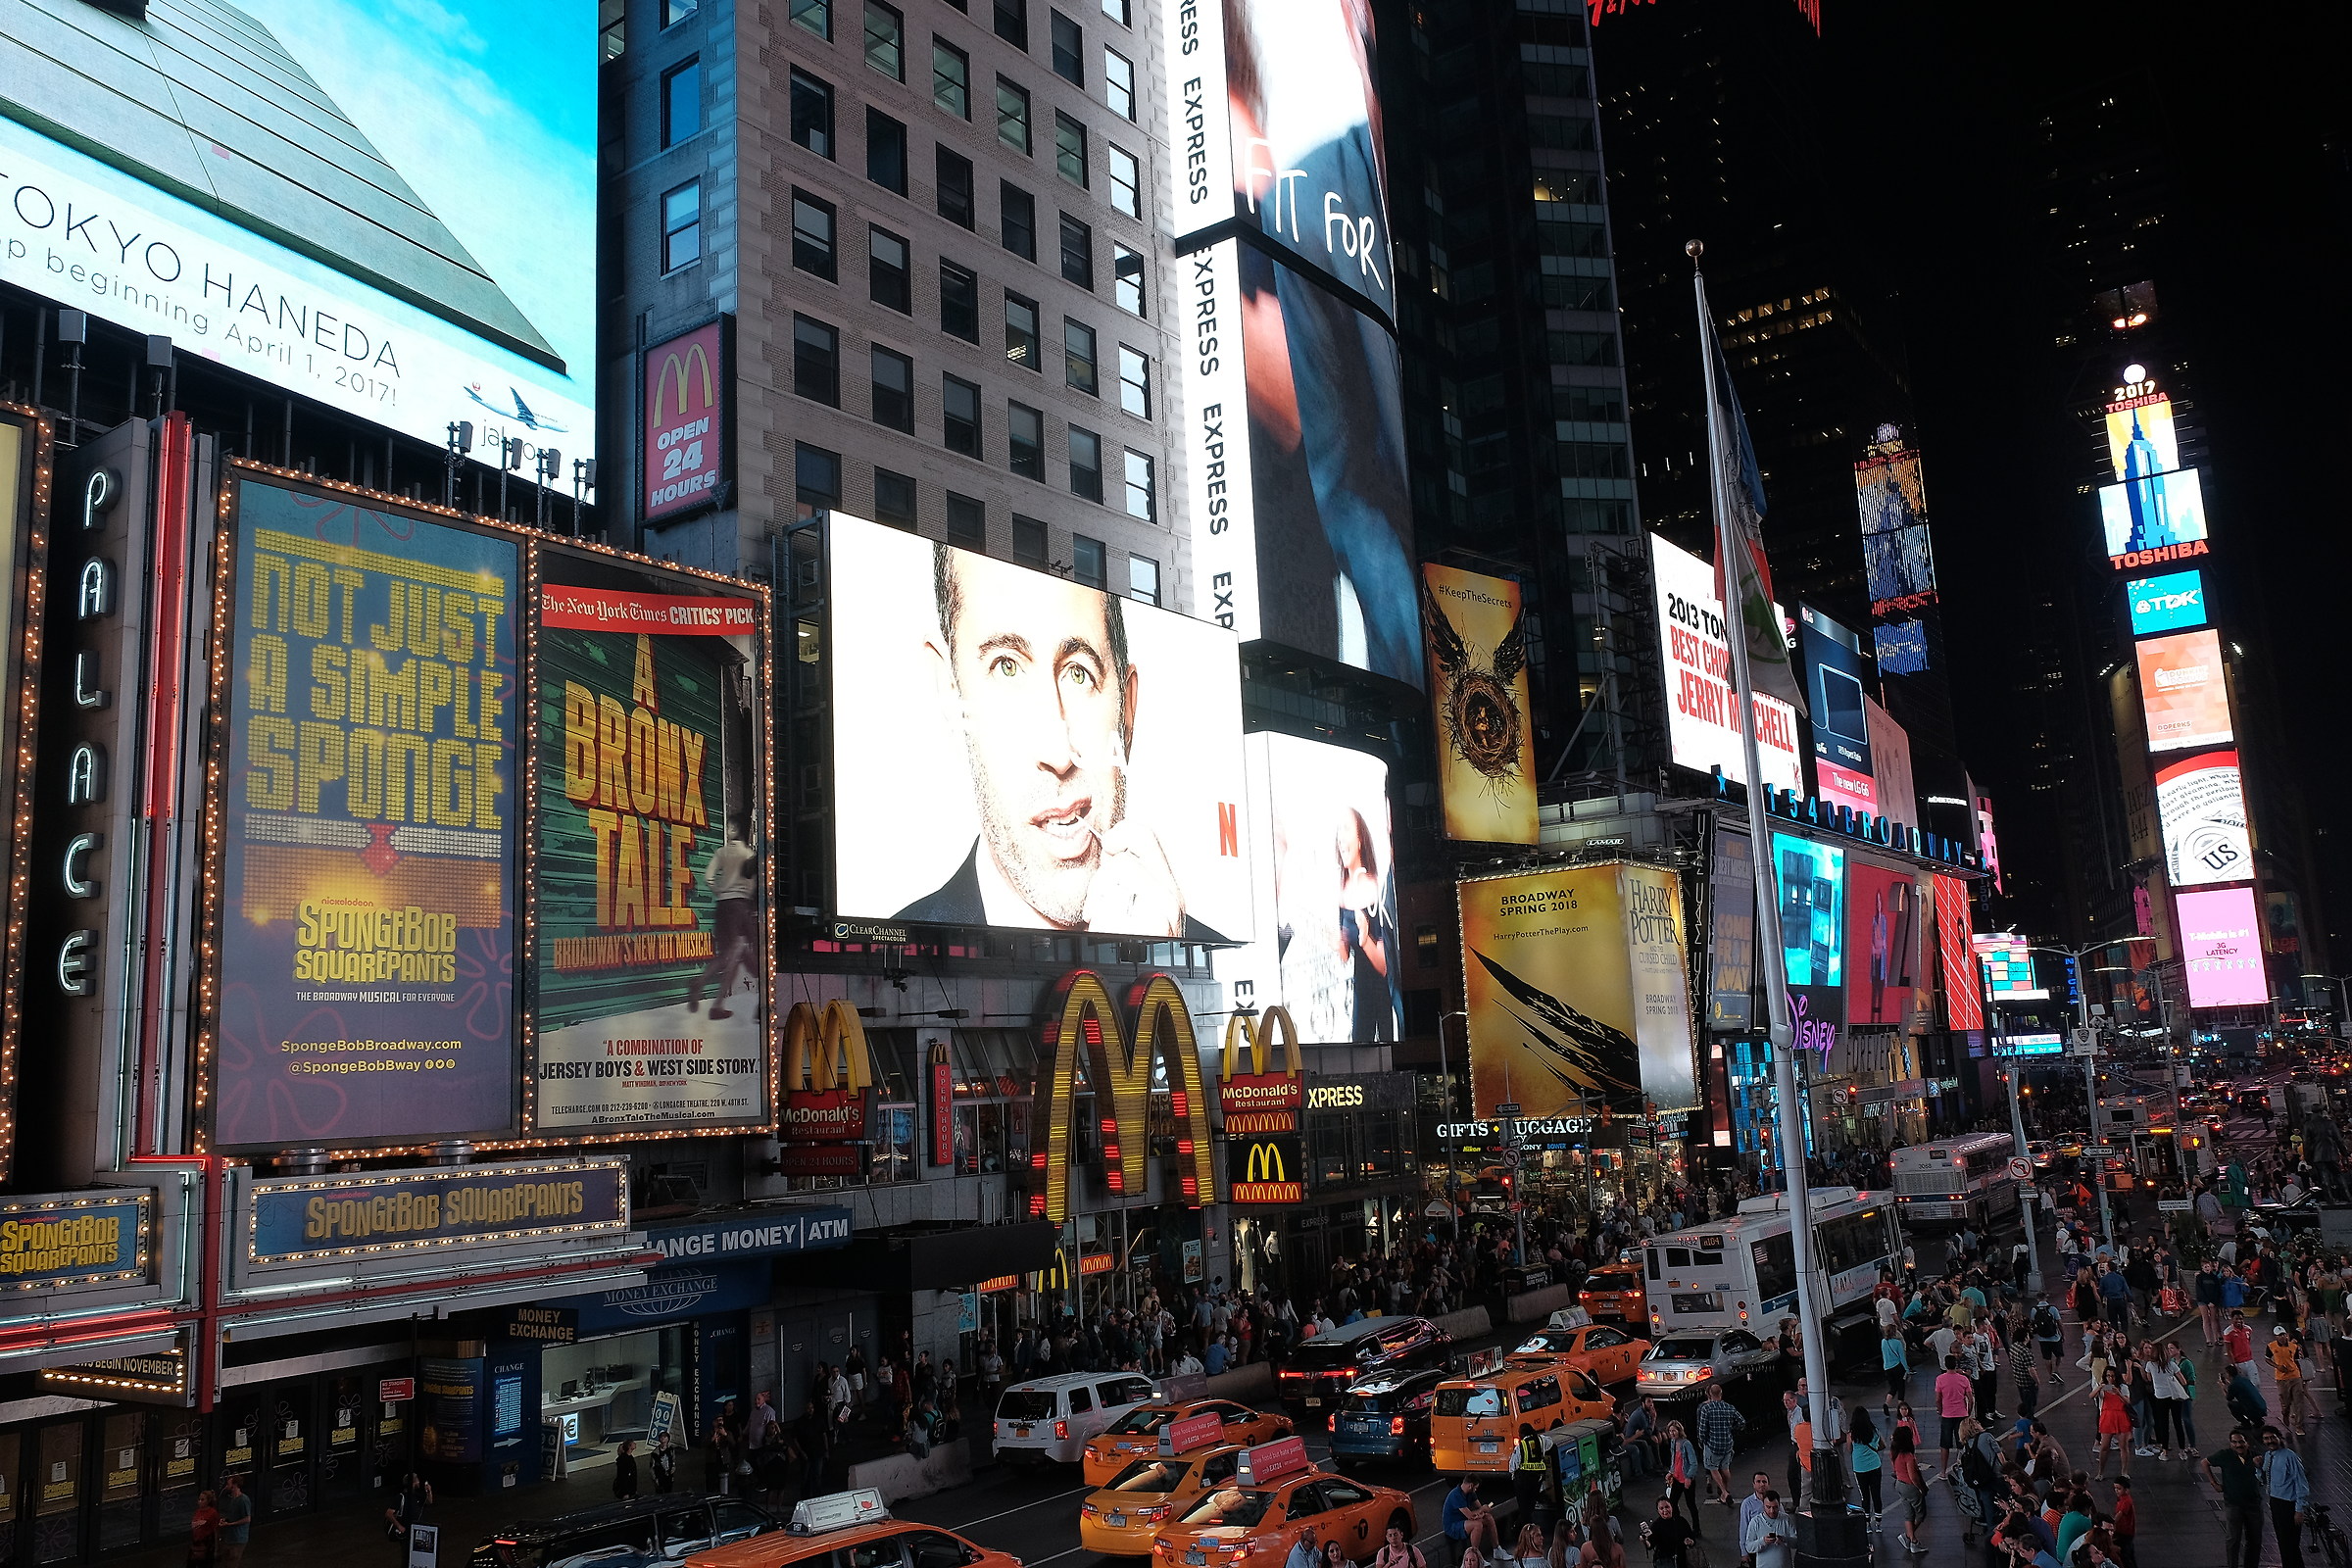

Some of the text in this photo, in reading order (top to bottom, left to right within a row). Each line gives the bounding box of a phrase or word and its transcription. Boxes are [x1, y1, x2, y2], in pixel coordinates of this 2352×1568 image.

[1183, 76, 1208, 205] EXPRESS
[1244, 136, 1308, 243] FIT
[0, 173, 400, 378] OKYO HANEDA
[47, 247, 208, 335] beginning
[224, 323, 291, 365] April
[334, 366, 397, 407] 2017!
[2105, 392, 2169, 414] TOSHIBA
[2114, 380, 2156, 402] 2017
[657, 416, 710, 451] OPEN
[662, 440, 704, 481] 24
[1203, 403, 1228, 536] EXPRESS
[651, 469, 716, 508] HOURS
[2110, 539, 2210, 570] TOSHIBA
[251, 552, 505, 668] NOT JUST
[1438, 584, 1513, 610] #KeepTheSecrets
[2149, 588, 2200, 612] TDK
[566, 597, 595, 615] New
[596, 600, 629, 621] York
[629, 602, 667, 622] Times
[725, 607, 755, 624] PICK
[1668, 592, 1700, 630] 2013
[1670, 624, 1700, 670] BEST
[633, 633, 656, 709] A
[248, 633, 504, 743] A SIMPLE
[1677, 668, 1794, 753] JERRY MCHELL
[59, 466, 119, 997] PALACE
[565, 679, 708, 827] BRONX
[245, 714, 503, 831] SPONGE
[1767, 783, 1962, 865] 1540 BROADWAY
[588, 808, 693, 926] TALE
[2201, 843, 2238, 870] US
[321, 897, 373, 907] nickelodeon
[1499, 900, 1578, 917] SPRING 2018
[1501, 888, 1575, 906] BROADWAY
[1629, 879, 1672, 917] HARRY
[1493, 924, 1589, 942] HarryPotterThePlay.com
[1629, 909, 1681, 946] POTTER
[1718, 912, 1751, 941] COME
[633, 934, 657, 961] NEW
[659, 933, 674, 959] HIT
[675, 932, 713, 958] MUSICAL
[1717, 938, 1751, 966] FROM
[2205, 948, 2238, 956] LATENCY
[1716, 963, 1750, 992] AWAY
[296, 991, 455, 1004] THE BROADWAY MUSICAL FOR EVERYONE
[1645, 994, 1677, 1004] BROADWAY
[1645, 1005, 1679, 1015] SPRING 2018
[280, 1039, 462, 1054] SpongeBobBroadway.com
[615, 1039, 704, 1056] COMBINATION OF
[288, 1059, 421, 1076] @SpongeBobBway
[539, 1061, 593, 1080] JERSEY
[595, 1060, 632, 1078] BOYS
[634, 1059, 645, 1077] &
[647, 1059, 683, 1077] WEST
[686, 1058, 713, 1076] SIDE
[1222, 1083, 1298, 1100] McDonald's
[1235, 1098, 1286, 1108] Restaurant
[1307, 1085, 1364, 1109] XPRESS
[591, 1110, 715, 1124] ABronxTaleTheMusical.com
[780, 1105, 859, 1124] McDonald's
[792, 1125, 846, 1136] Restaurant
[1437, 1118, 1592, 1138] GIFTS UGGAGE
[783, 1156, 855, 1167] OPEN 24 HOURS
[1301, 1216, 1329, 1228] EXPRESS
[647, 1218, 849, 1258] ANGE MONEY ATM
[605, 1277, 718, 1305] MONEY EXCHANGE
[517, 1308, 562, 1324] MONEY
[510, 1323, 574, 1341] EXCHANGE
[95, 1357, 122, 1370] BEGIN
[123, 1357, 173, 1376] NOVEMBER
[494, 1362, 524, 1374] CHANGE
[1171, 1429, 1182, 1438] Love
[1181, 1426, 1191, 1435] food
[1198, 1422, 1206, 1431] hate
[1250, 1456, 1261, 1465] Love
[1261, 1453, 1272, 1462] food
[1279, 1448, 1290, 1457] hate
